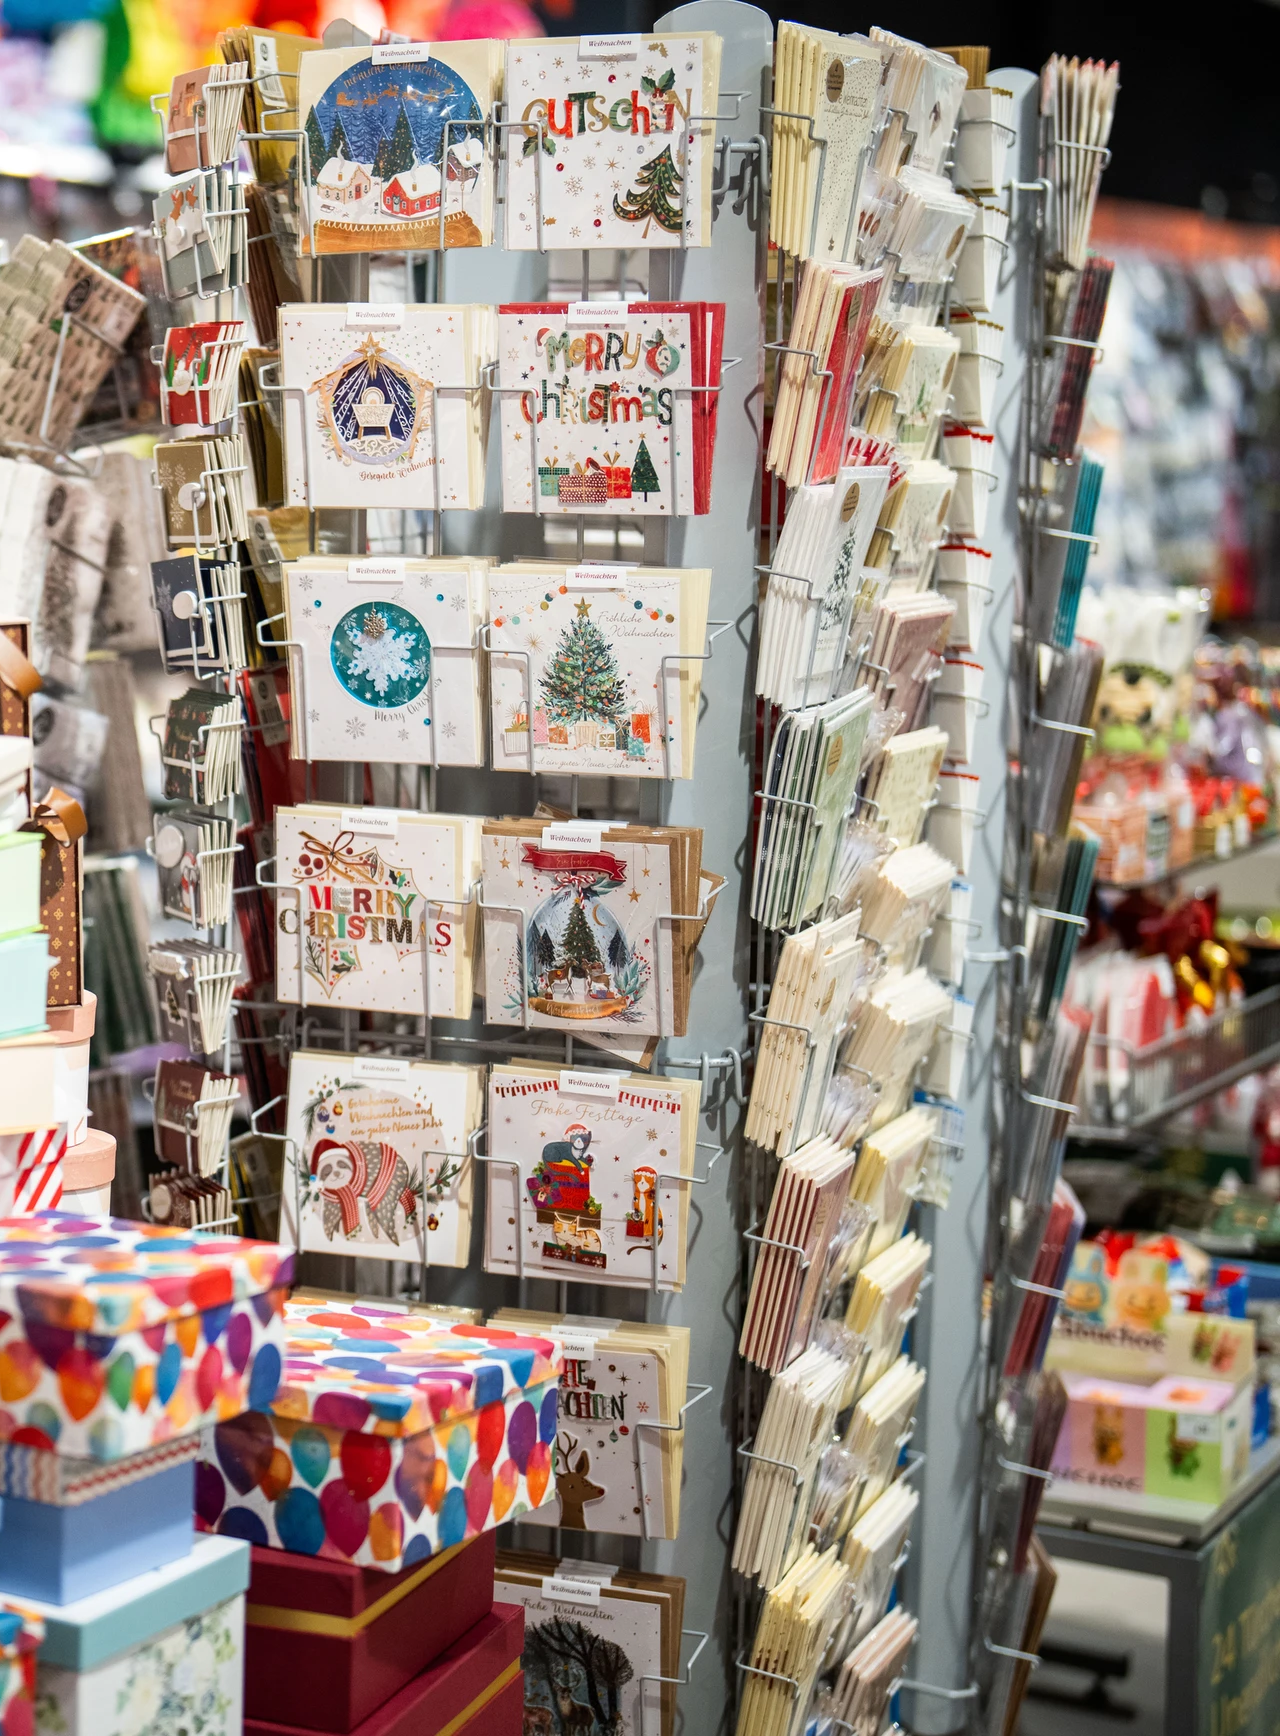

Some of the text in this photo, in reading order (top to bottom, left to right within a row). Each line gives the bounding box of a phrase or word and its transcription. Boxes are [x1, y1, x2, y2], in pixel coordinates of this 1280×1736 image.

[588, 39, 632, 47] Weihnachten
[380, 49, 421, 57] Weihnachten
[576, 308, 619, 316] Weihnachten
[359, 456, 446, 482] Gesegnete Weihnachtn
[574, 572, 618, 580] Weihnachten
[597, 610, 643, 625] Fröhliche
[608, 625, 675, 638] Weihnachten
[374, 677, 442, 723] Merry Christas
[558, 759, 579, 770] gutes
[580, 757, 606, 768] Neues
[606, 758, 632, 769] Jahr
[348, 817, 389, 826] Weihnachten
[549, 834, 592, 844] Weihnachten
[308, 885, 418, 918] MERRY
[361, 1064, 400, 1072] Weihnachten
[568, 1078, 610, 1090] Weihnachten
[349, 1102, 433, 1123] Weihnachten und
[531, 1099, 644, 1128] Frohe Festtage
[350, 1116, 443, 1139] ein gutes Neues Jahr
[563, 1344, 585, 1352] achten
[557, 1391, 624, 1420] ACHTEN
[550, 1584, 592, 1597] Weihnachten
[552, 1602, 615, 1621] Weihnachten
